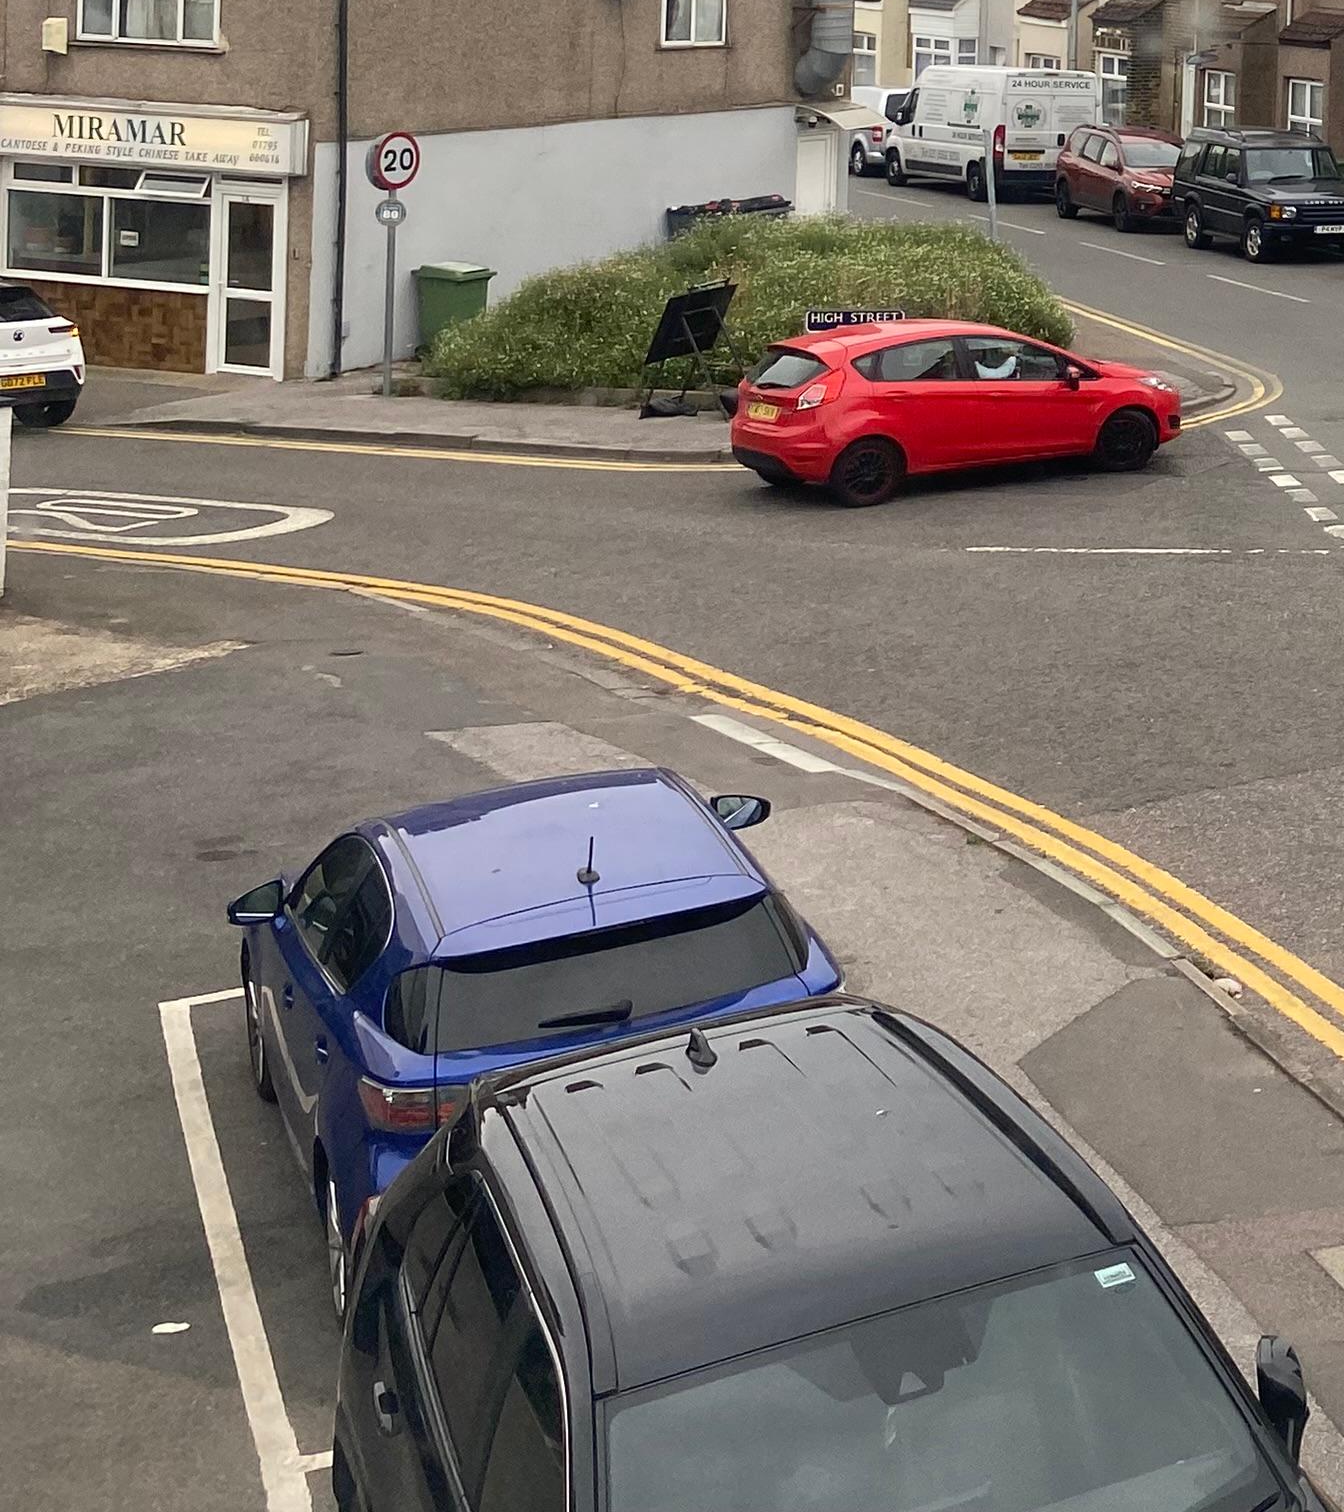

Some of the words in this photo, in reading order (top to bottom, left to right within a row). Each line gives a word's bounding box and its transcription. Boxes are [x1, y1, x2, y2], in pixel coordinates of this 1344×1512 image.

[1012, 80, 1022, 88] 24
[1024, 80, 1050, 88] HOUR
[1053, 81, 1091, 89] SERVICE
[52, 113, 186, 146] MIRAMAR
[53, 142, 59, 152] &
[65, 143, 100, 154] PEKING
[106, 145, 133, 157] STYLE
[139, 148, 179, 160] CHINESE
[185, 151, 208, 162] TAKE
[212, 153, 240, 166] AWAY
[384, 148, 414, 172] 20
[811, 312, 843, 323] HIGH
[850, 312, 899, 322] STREET
